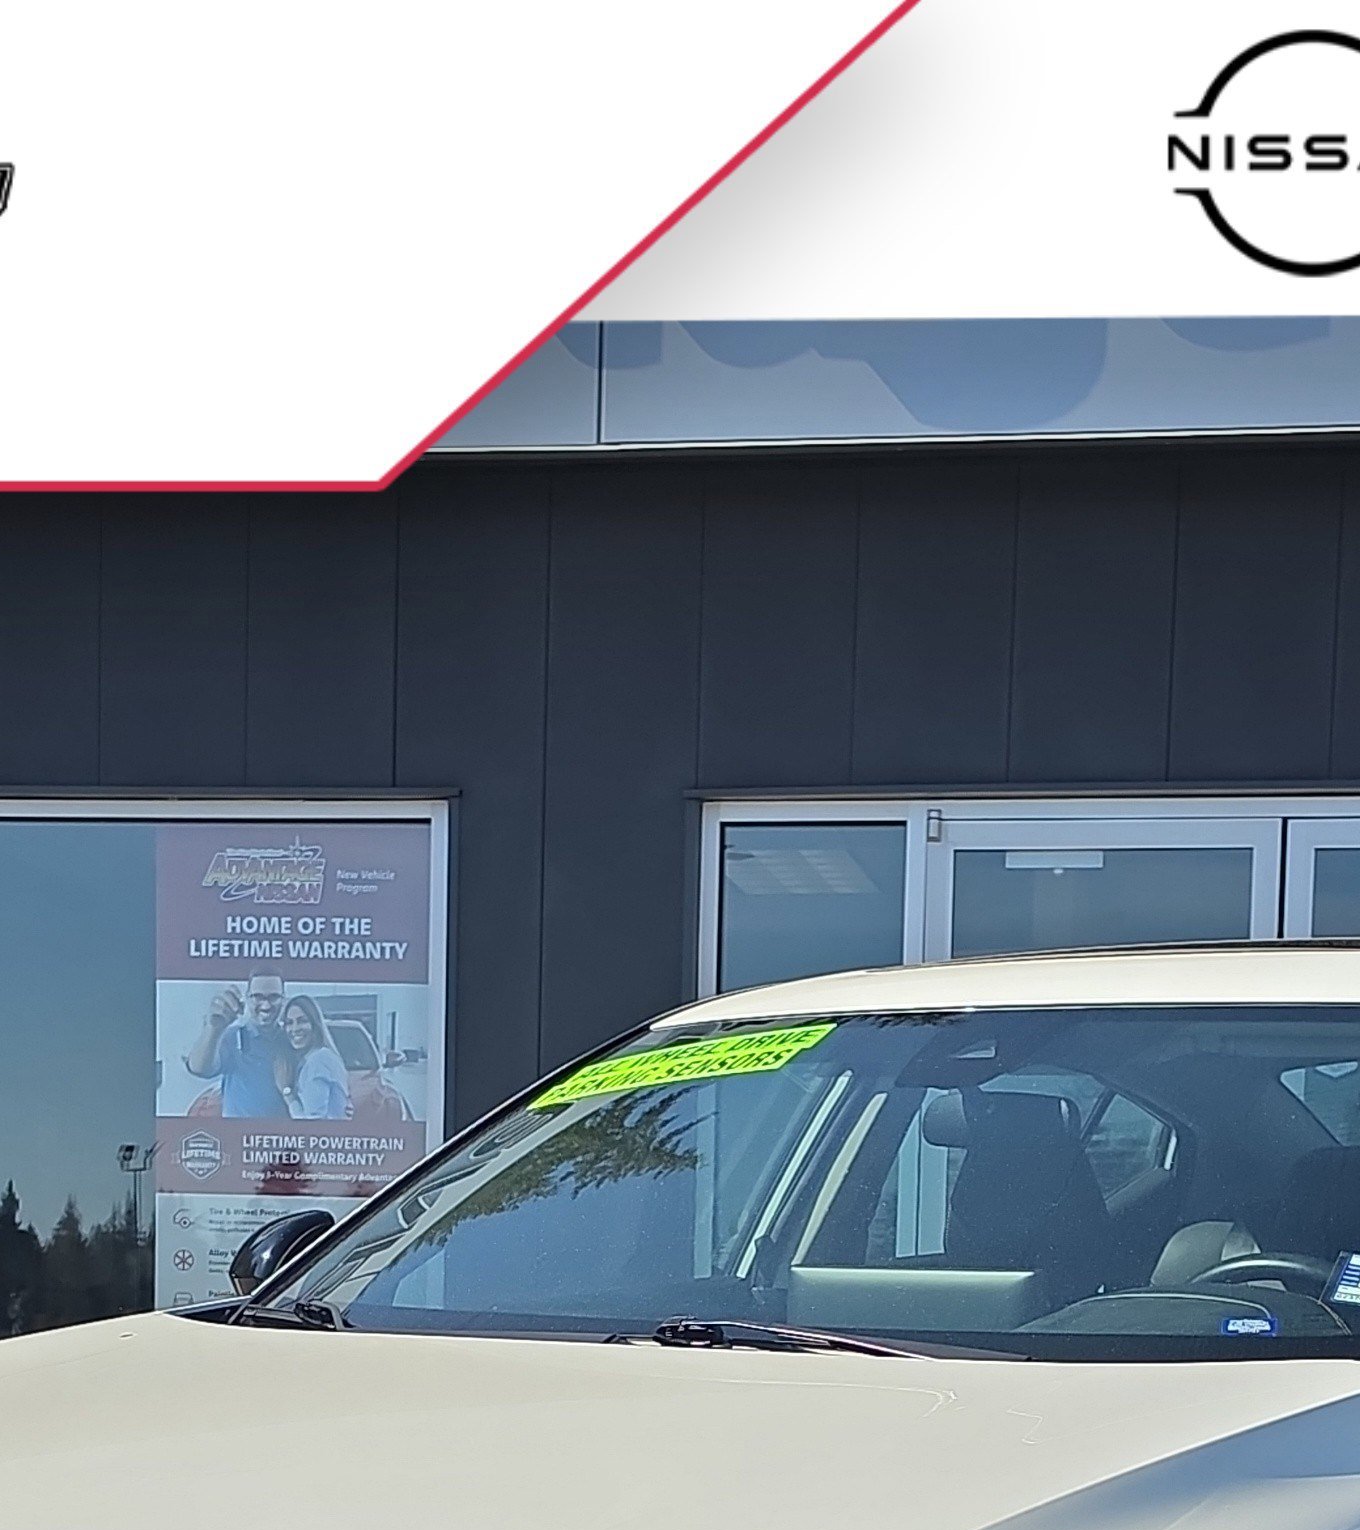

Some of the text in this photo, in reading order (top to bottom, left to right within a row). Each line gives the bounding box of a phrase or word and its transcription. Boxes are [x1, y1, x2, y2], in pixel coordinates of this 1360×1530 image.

[336, 869, 396, 880] New Vehicle
[336, 882, 378, 895] Program
[226, 916, 371, 936] HOME OF THE
[190, 939, 408, 960] LIFETIME WARRANTY
[631, 1042, 727, 1068] WHEEL
[728, 1029, 824, 1051] DRIVE
[655, 1048, 791, 1080] SENSORS
[243, 1134, 404, 1151] LIFETIME POWERTRAIN
[242, 1150, 385, 1166] LIMITED WARRANTY
[242, 1169, 265, 1181] Enjoy
